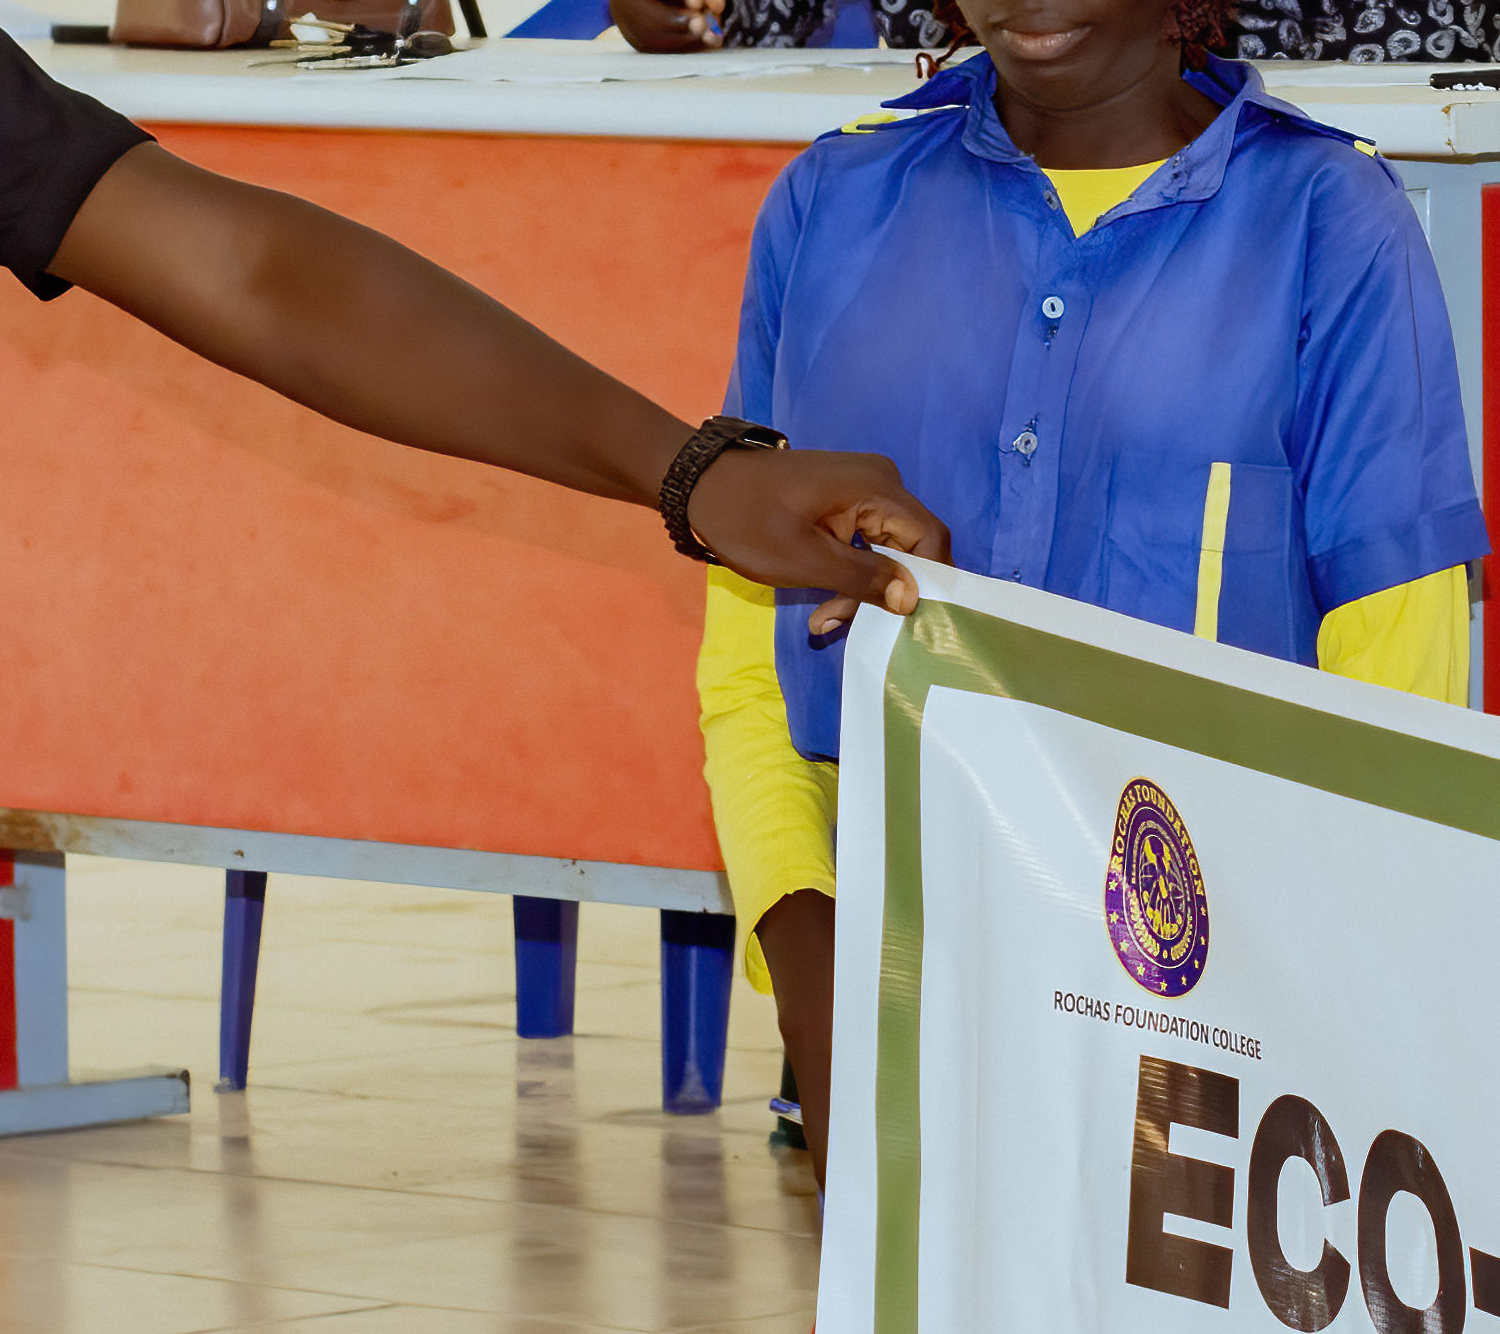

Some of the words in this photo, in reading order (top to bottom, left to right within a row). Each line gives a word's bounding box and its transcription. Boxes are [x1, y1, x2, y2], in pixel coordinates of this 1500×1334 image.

[1054, 990, 1111, 1022] ROCHAS
[1115, 1003, 1209, 1045] FOUNDATION
[1212, 1027, 1263, 1060] COLLEGE
